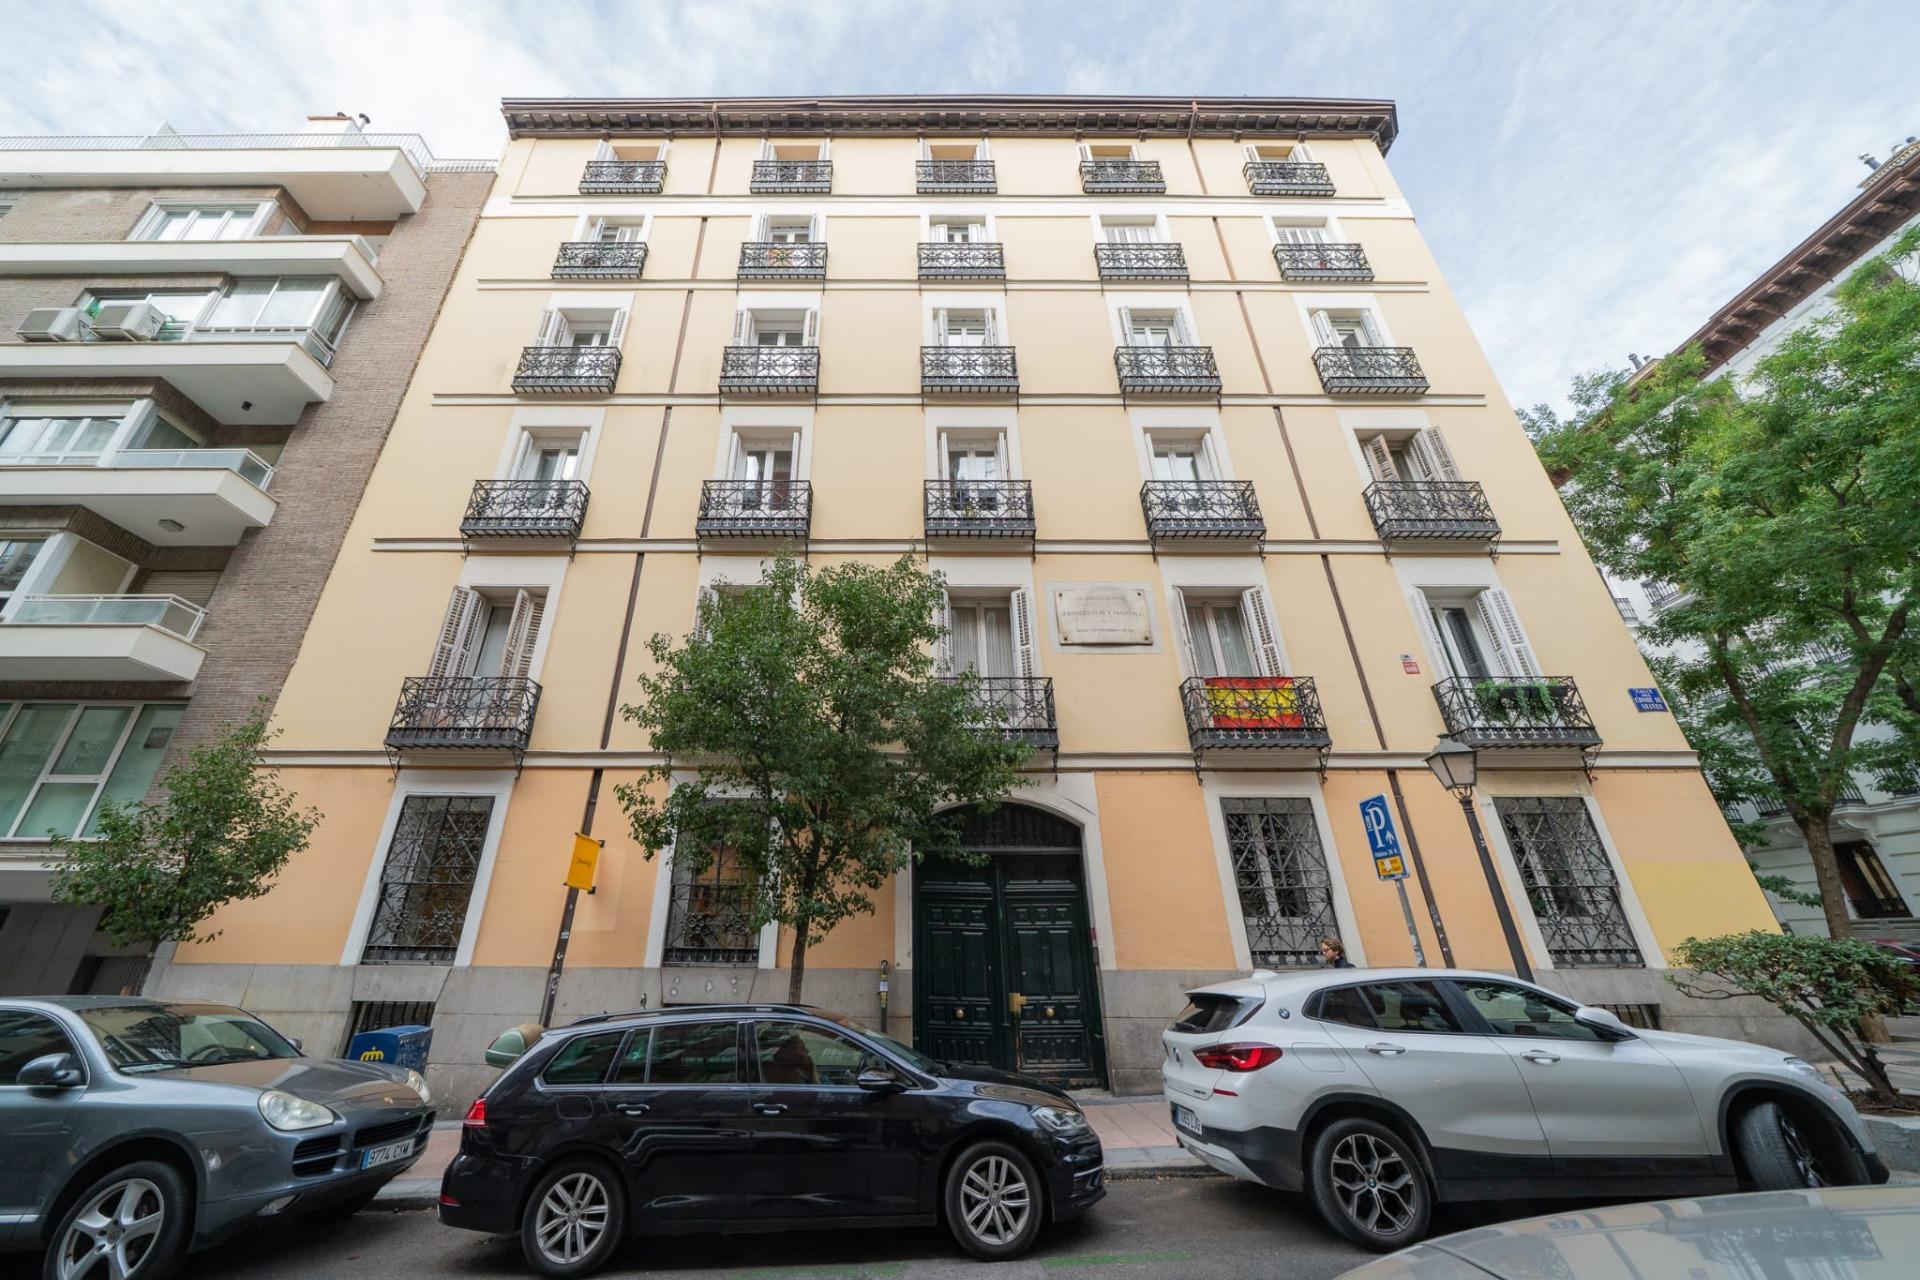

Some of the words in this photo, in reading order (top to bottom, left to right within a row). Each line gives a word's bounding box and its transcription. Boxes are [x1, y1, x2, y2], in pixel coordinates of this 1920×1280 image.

[1366, 806, 1386, 848] P
[369, 1146, 391, 1165] 9774
[393, 1142, 410, 1158] CYM
